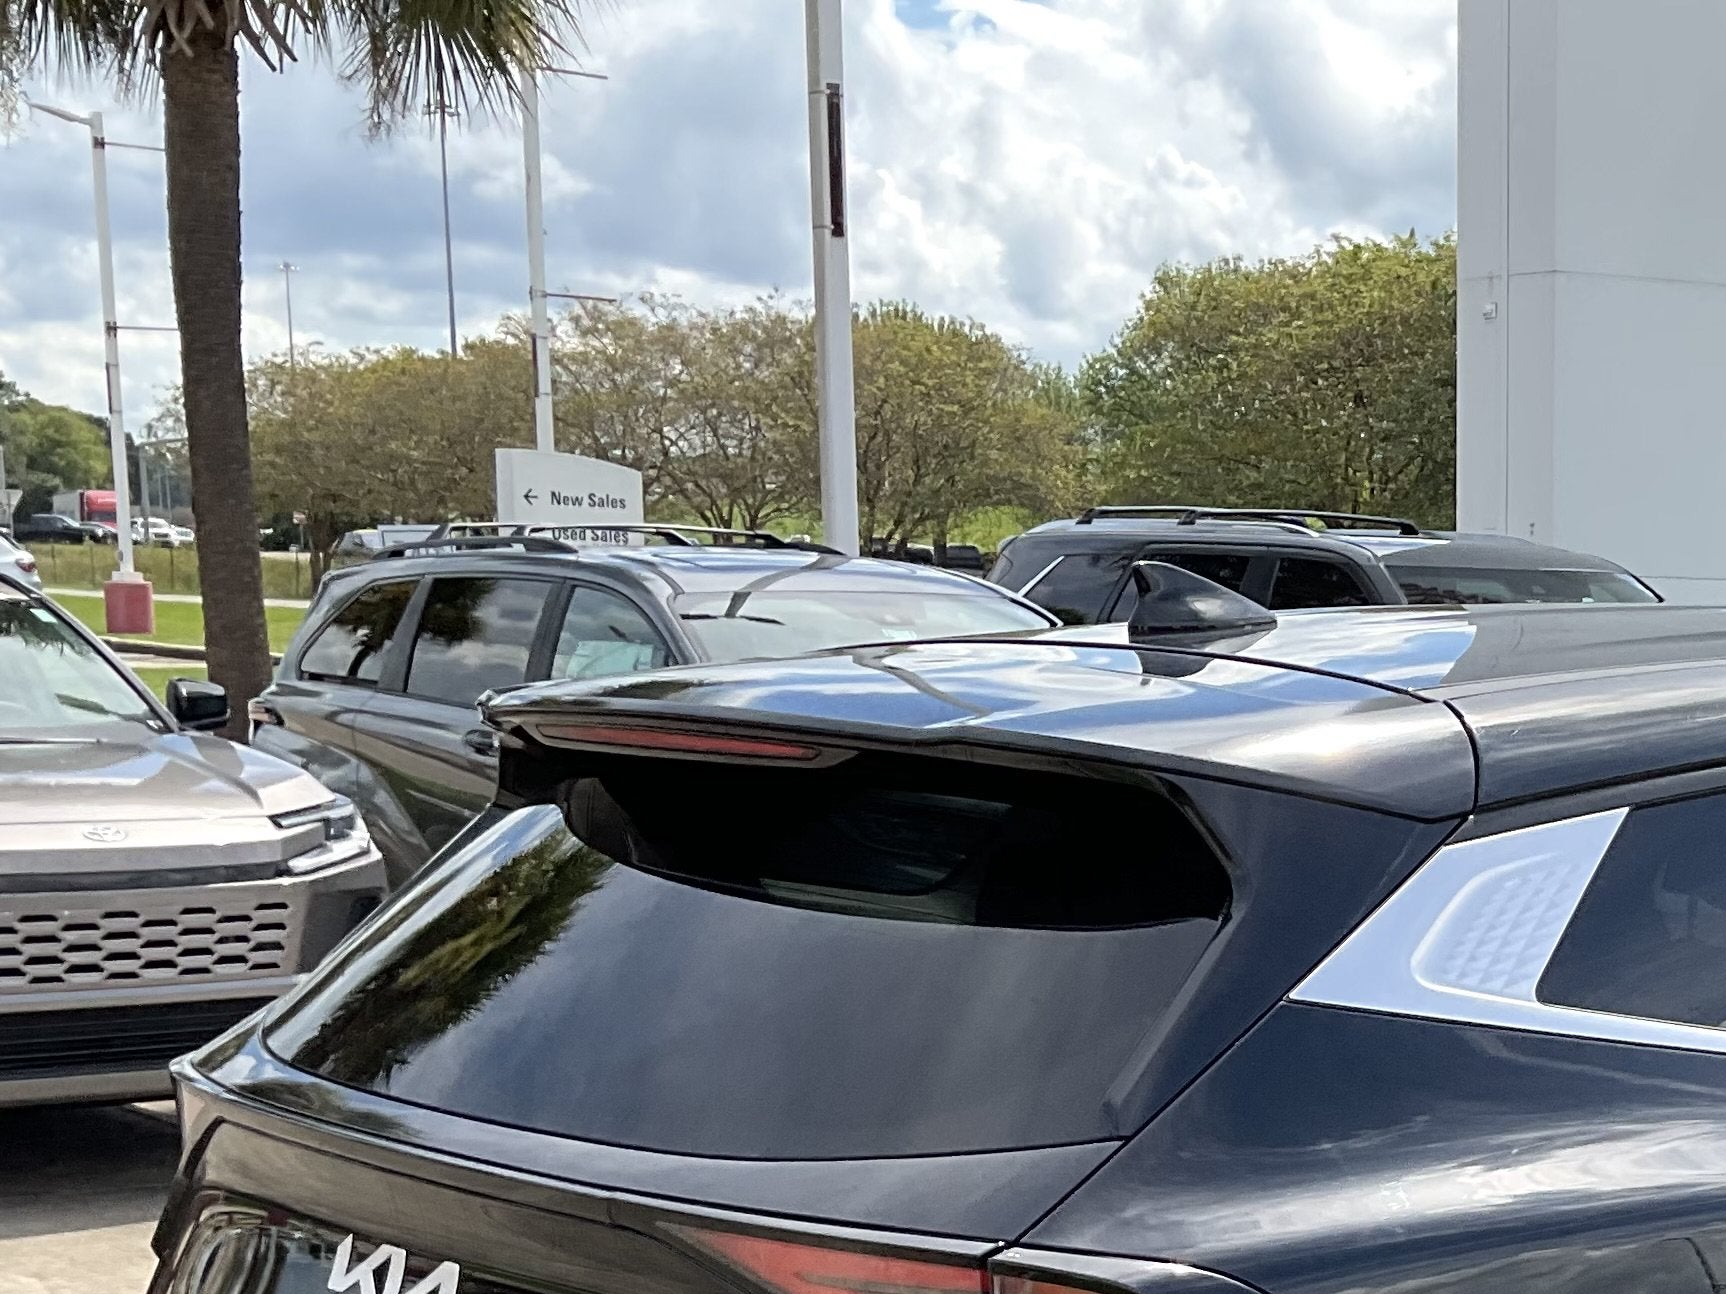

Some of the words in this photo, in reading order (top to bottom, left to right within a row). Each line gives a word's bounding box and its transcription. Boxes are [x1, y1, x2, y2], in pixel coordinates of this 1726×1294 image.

[550, 490, 584, 506] New
[587, 493, 626, 509] Sales
[552, 527, 586, 541] Used
[590, 529, 629, 545] Sales
